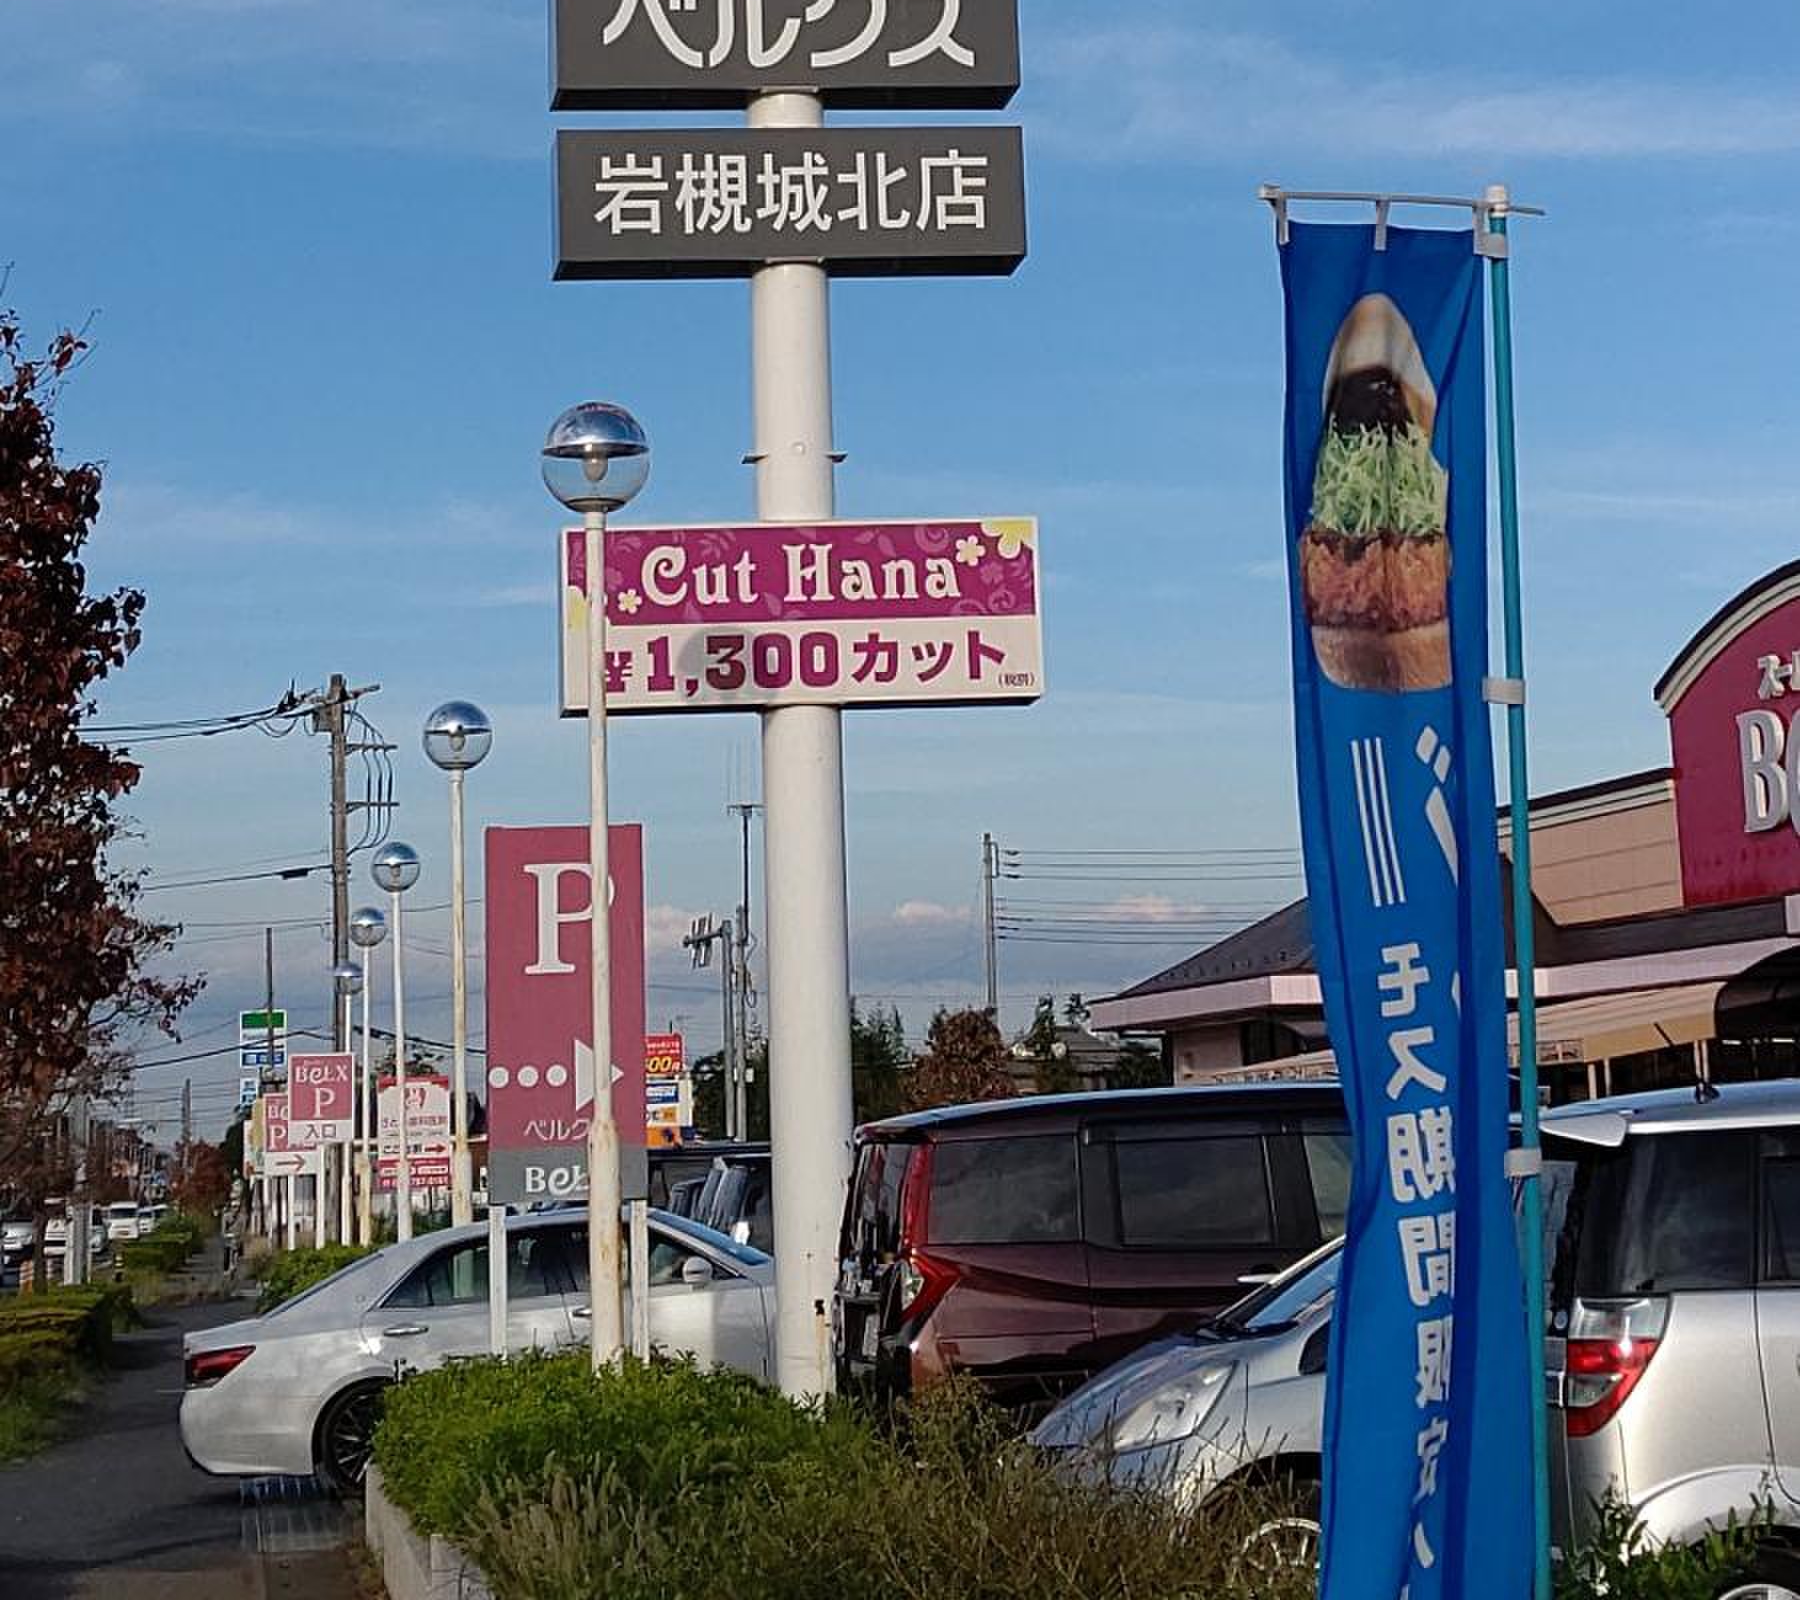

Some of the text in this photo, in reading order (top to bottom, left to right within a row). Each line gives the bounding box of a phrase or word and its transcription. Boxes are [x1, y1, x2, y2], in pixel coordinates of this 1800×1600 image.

[594, 149, 988, 235] 岩槻城北店
[640, 544, 961, 606] Cut Hana
[523, 863, 615, 975] P
[313, 1087, 335, 1118] P
[268, 1124, 287, 1149] P
[304, 1123, 336, 1139] 入口
[523, 1119, 590, 1142] ベルク
